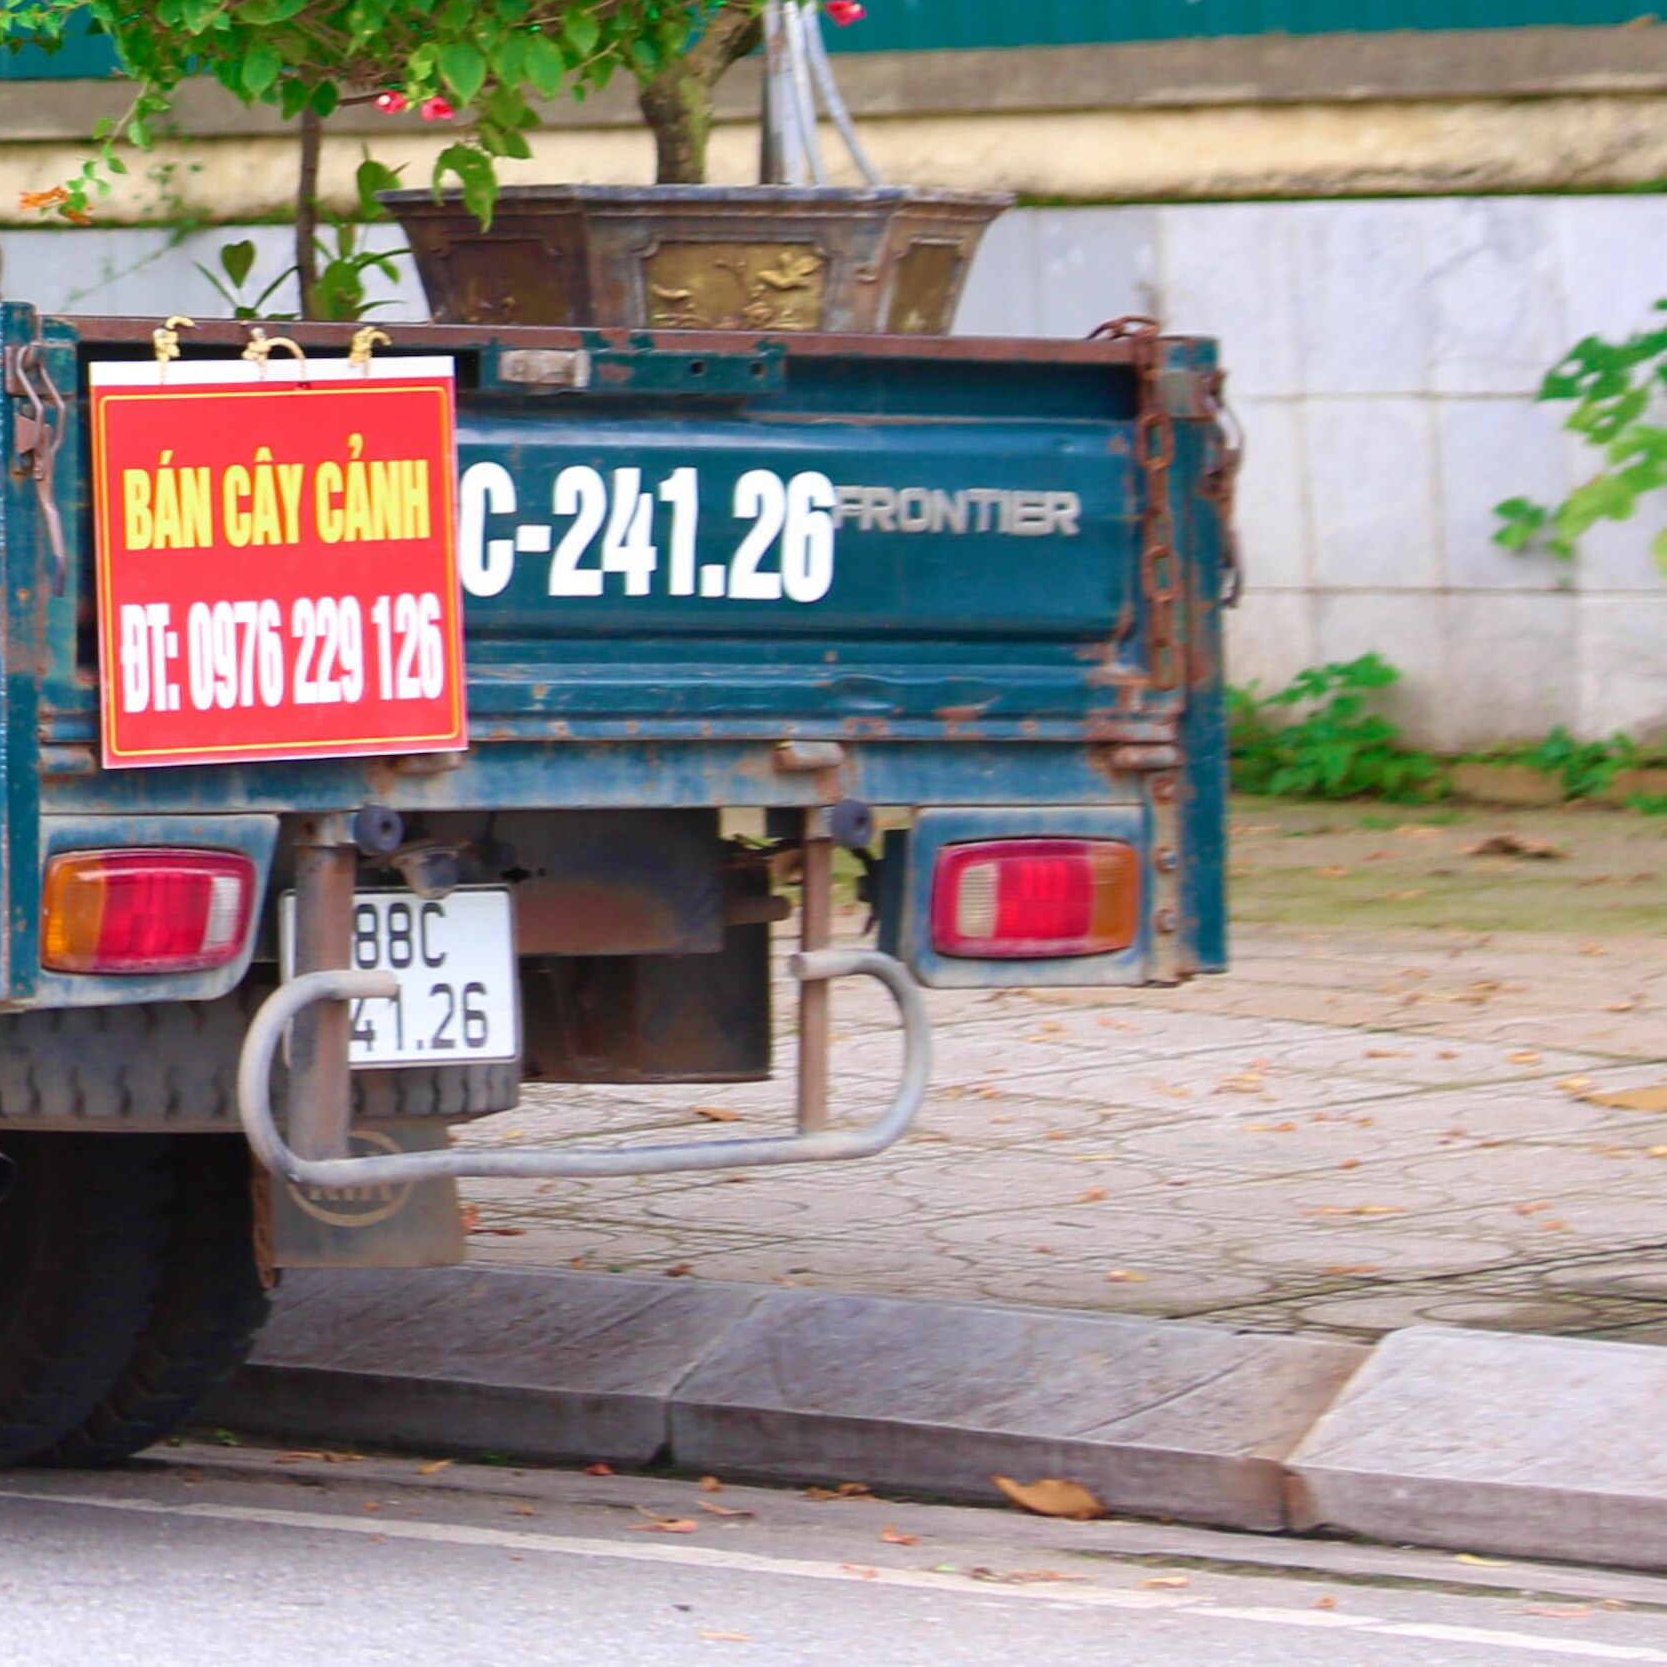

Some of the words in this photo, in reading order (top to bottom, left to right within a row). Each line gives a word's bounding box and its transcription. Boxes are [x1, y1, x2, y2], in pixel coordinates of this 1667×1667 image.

[122, 449, 213, 551] BÁN
[222, 446, 305, 548] CÂY
[314, 432, 432, 545] CẢNH
[833, 484, 1081, 537] FRONTIER
[119, 601, 181, 714] ĐT:
[186, 598, 286, 712] 0976
[290, 594, 365, 706] 229
[369, 591, 445, 702] 126
[354, 900, 447, 971] 88C
